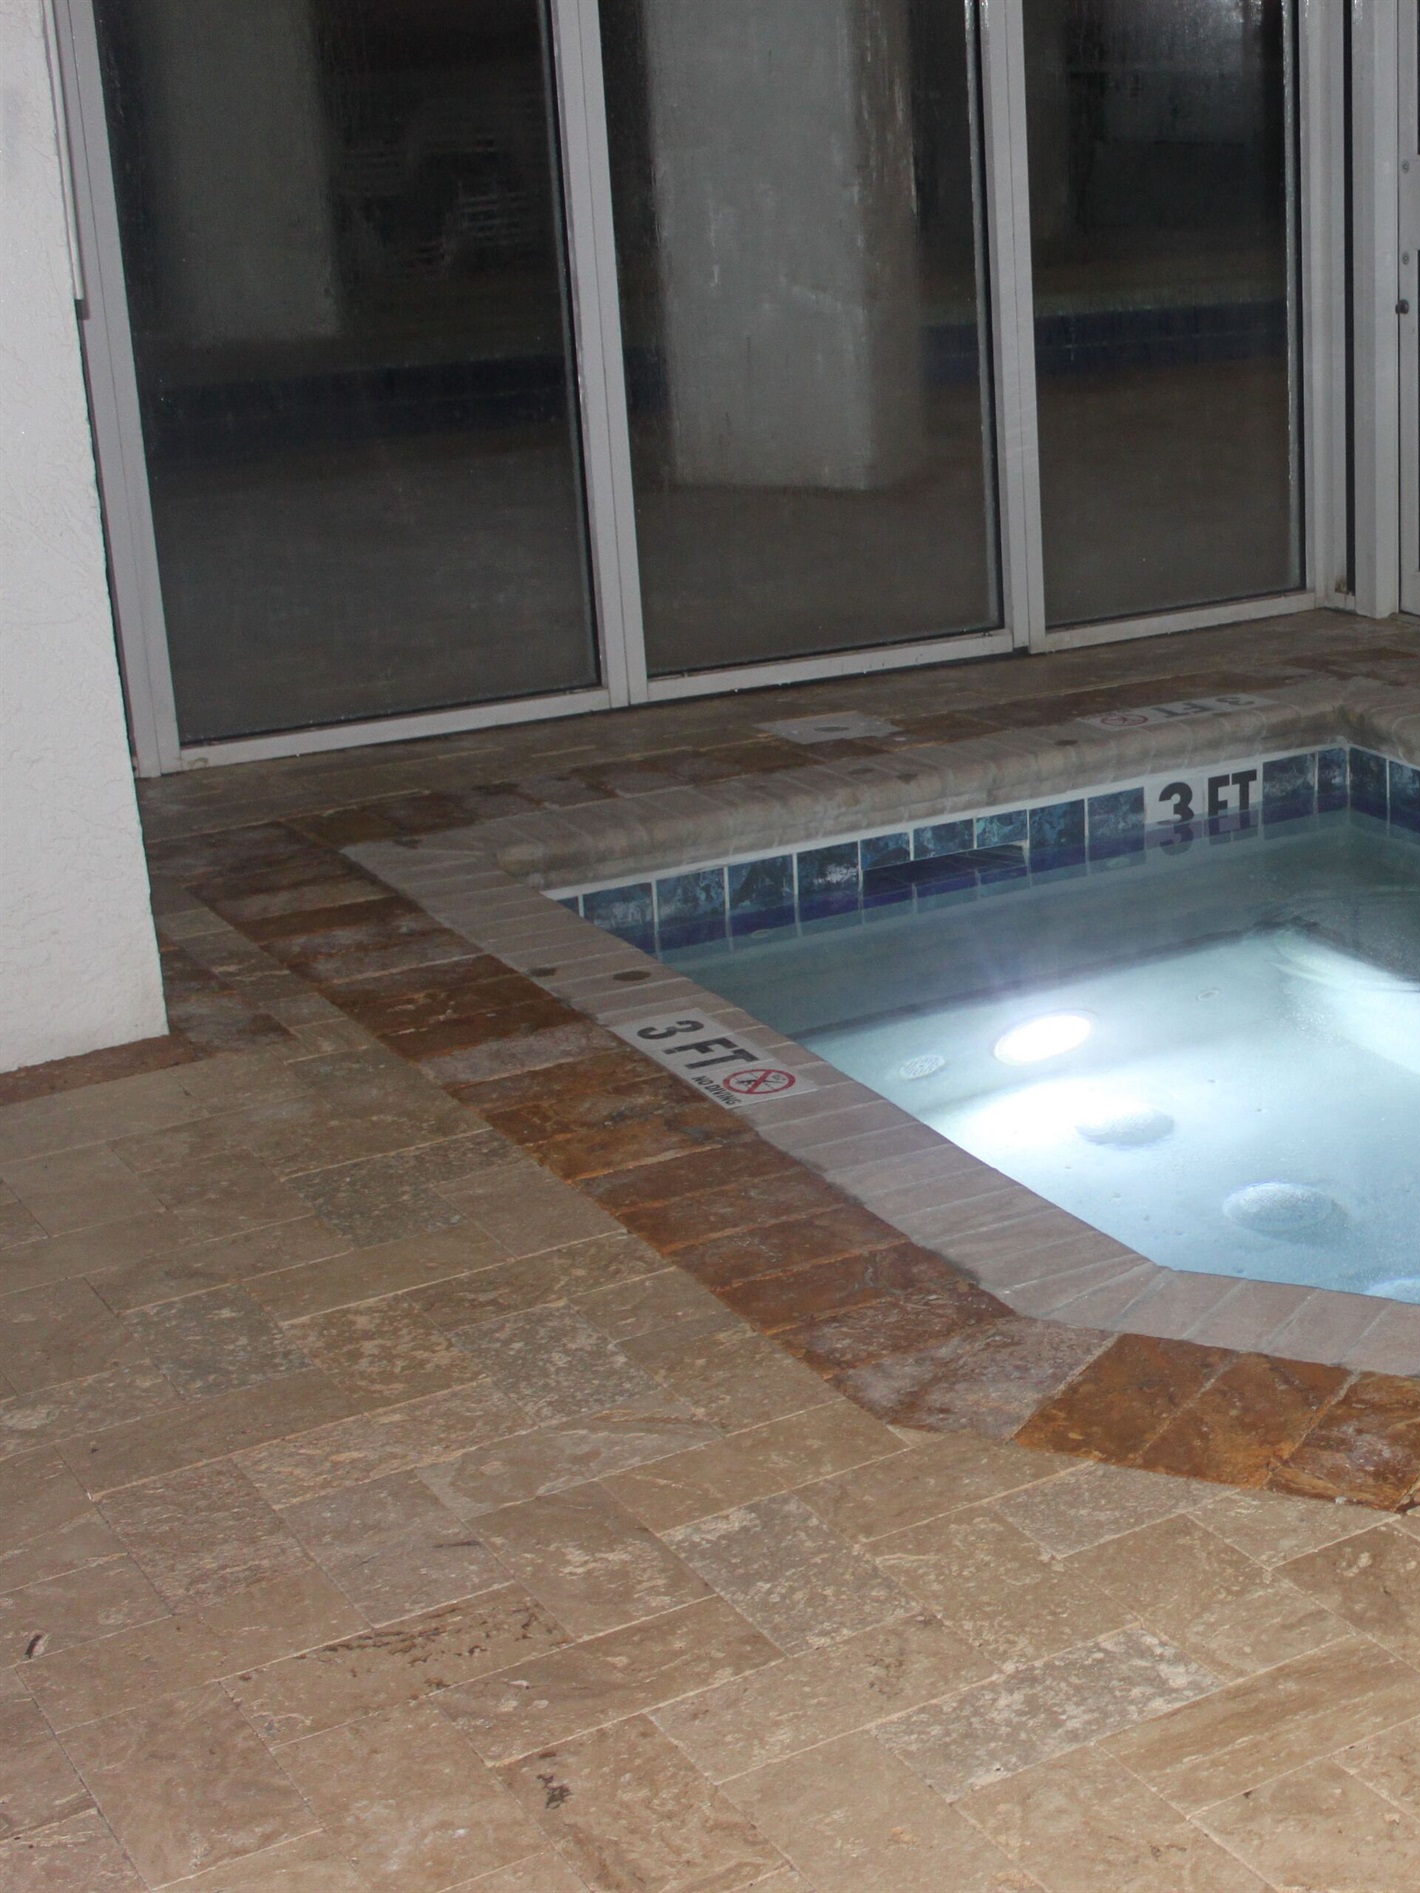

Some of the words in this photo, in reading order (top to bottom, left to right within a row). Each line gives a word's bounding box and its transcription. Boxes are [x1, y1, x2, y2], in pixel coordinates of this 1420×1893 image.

[1159, 782, 1194, 823] 3
[1208, 769, 1257, 817] FT
[637, 1020, 704, 1040] 3
[662, 1038, 760, 1070] FT
[692, 1076, 714, 1086] NO
[705, 1084, 742, 1106] DIVING
